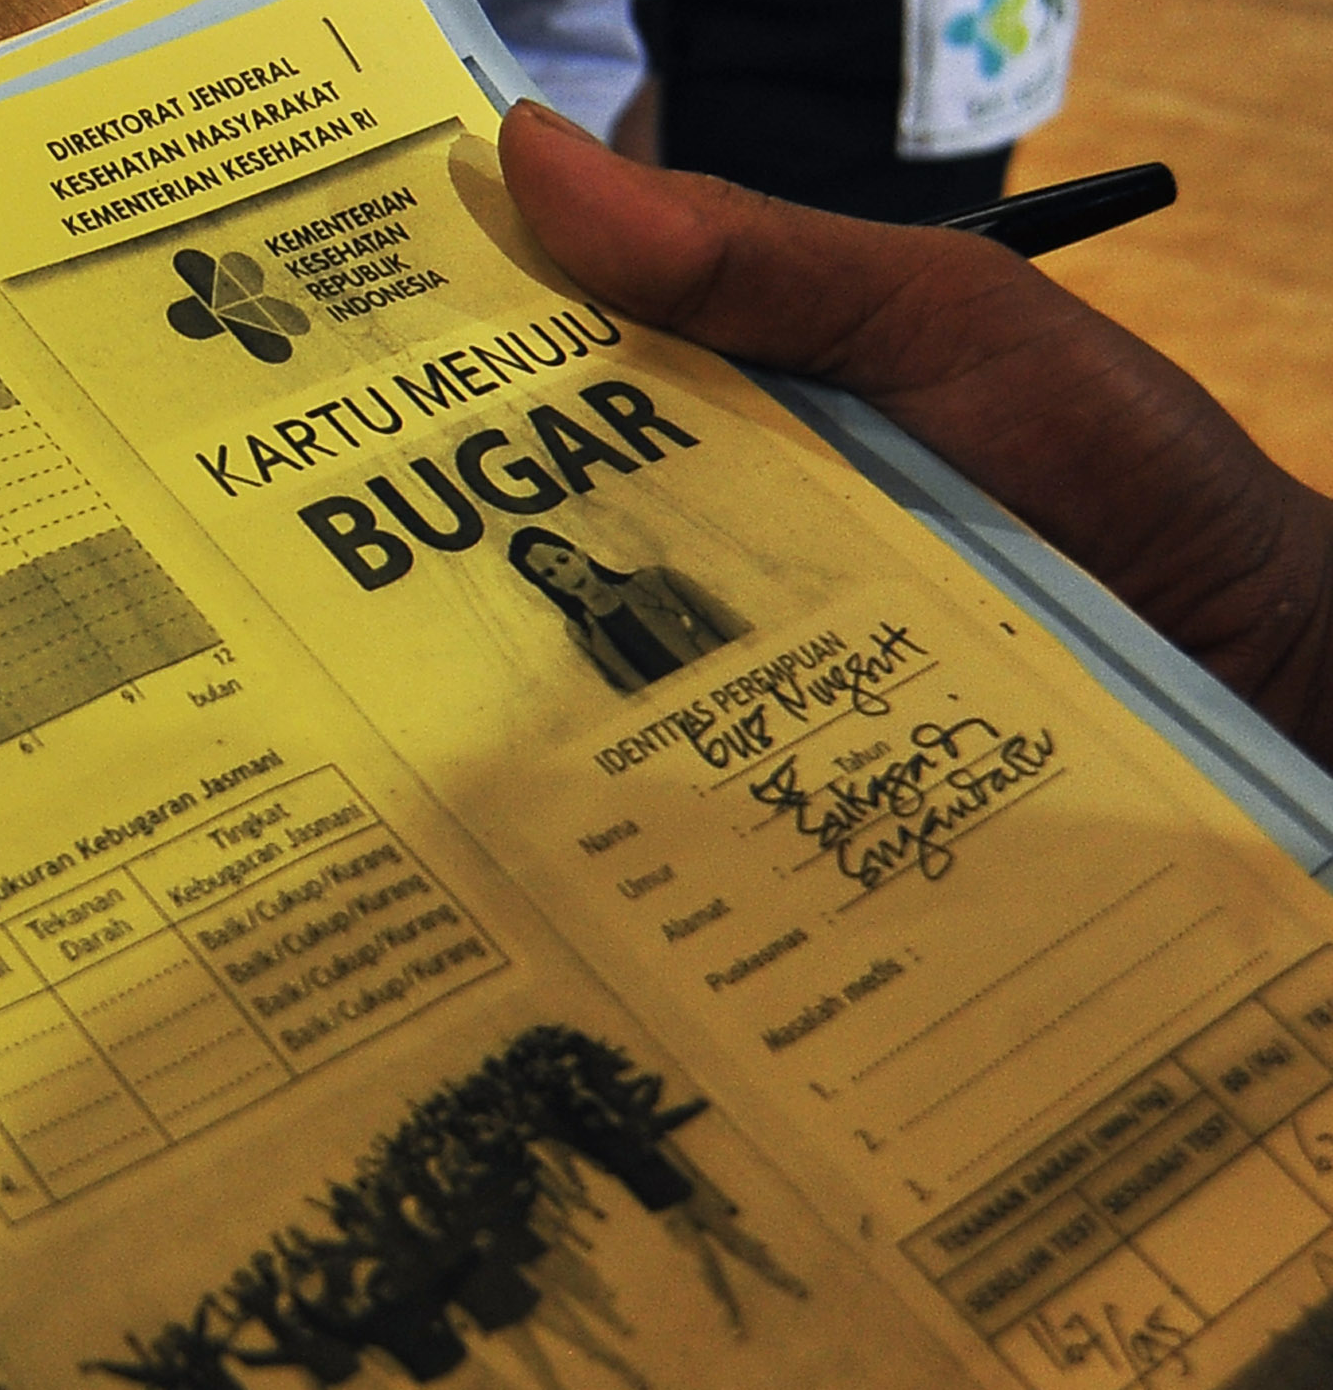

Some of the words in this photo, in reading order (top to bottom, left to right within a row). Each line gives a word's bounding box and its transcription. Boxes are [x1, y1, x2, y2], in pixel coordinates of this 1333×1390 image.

[45, 96, 186, 163] DIREKTORAT
[190, 56, 301, 115] JENDERAL
[49, 137, 187, 201] KESEHATAN
[187, 79, 343, 155] MASYARAKAT
[60, 168, 223, 238] KEMENTERIAN
[224, 118, 353, 184] KESEHATAN
[353, 108, 379, 135] RI
[264, 186, 419, 258] KEMENTERIAN
[284, 223, 411, 280] KESEHATAN
[305, 253, 412, 302] REPUBLIK
[325, 267, 450, 323] INDONESIA
[195, 386, 404, 498] KARTU
[402, 302, 623, 417] MENUJU
[296, 379, 701, 592] BUGAR
[187, 675, 244, 710] bulan
[212, 648, 236, 668] 12
[593, 701, 716, 776] IDENTITAS
[709, 630, 849, 712] PEREMPUAN
[73, 789, 198, 860] Kebugaran
[200, 747, 284, 799] Jasmani
[206, 800, 292, 852] Tingkat
[166, 841, 284, 908] Kebugaran
[284, 800, 367, 849] Jasmani
[24, 885, 126, 941] Tekanan
[57, 916, 135, 963] Darah
